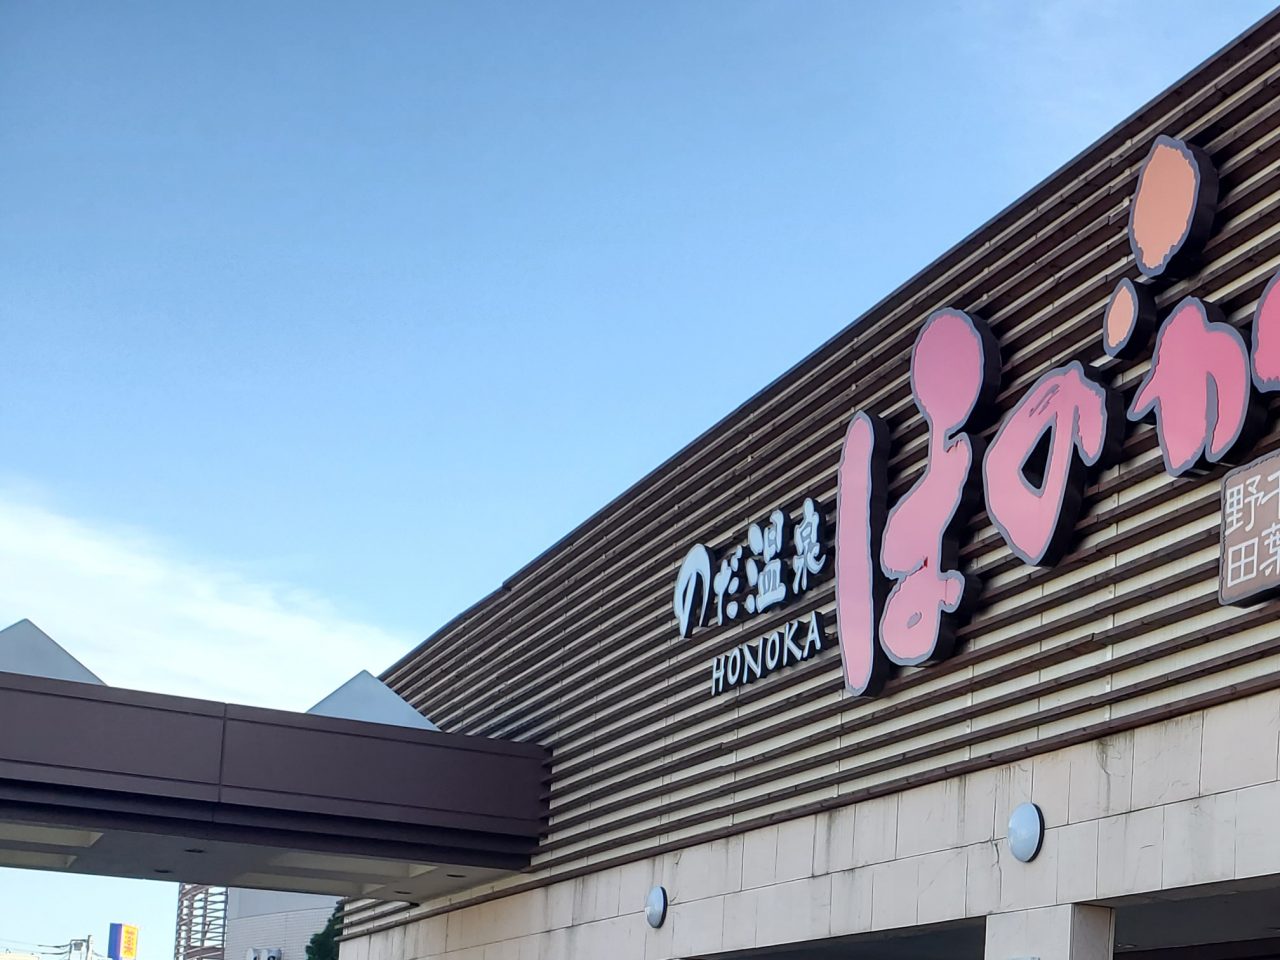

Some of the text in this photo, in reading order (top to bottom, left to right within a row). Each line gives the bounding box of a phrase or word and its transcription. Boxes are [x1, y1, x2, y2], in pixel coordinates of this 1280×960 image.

[673, 497, 827, 639] のだ温泉
[1225, 474, 1265, 588] 野田
[711, 610, 821, 696] HONOKA
